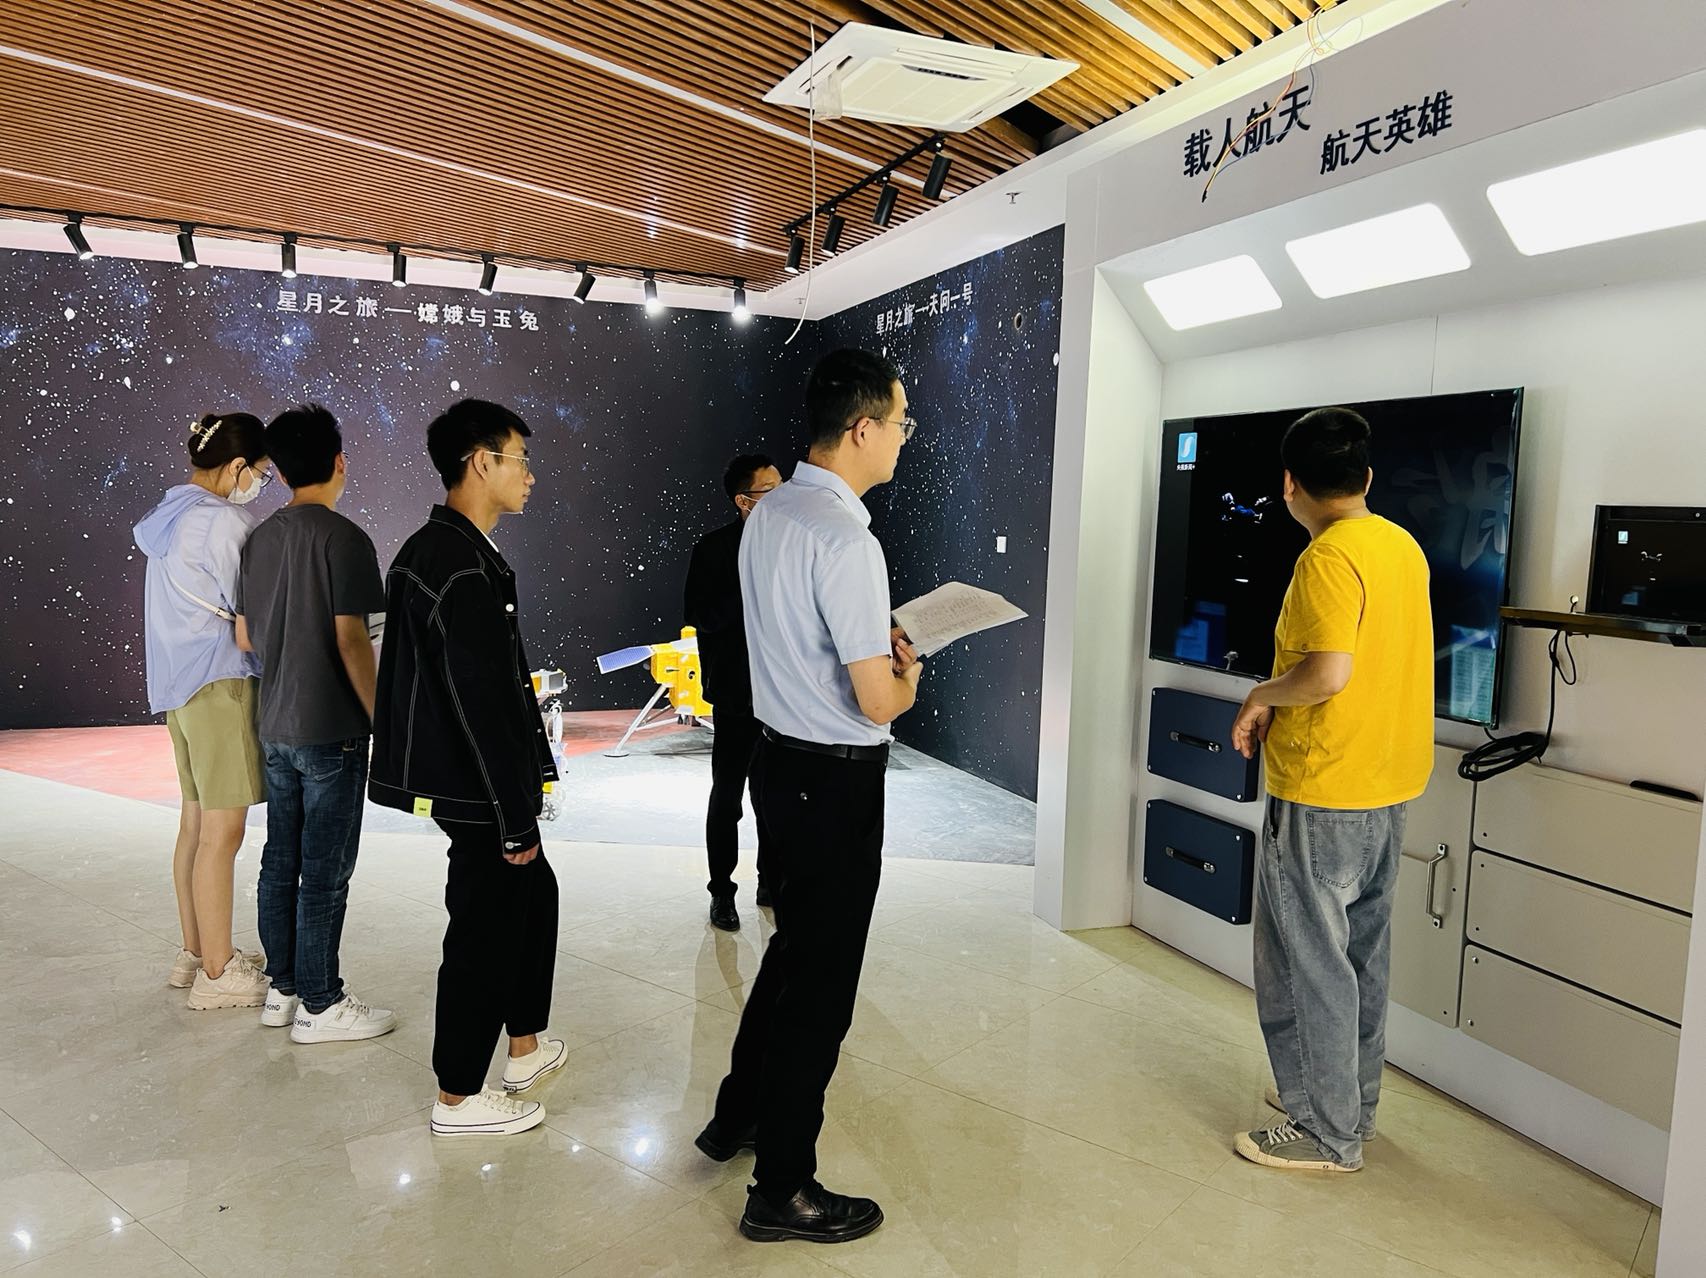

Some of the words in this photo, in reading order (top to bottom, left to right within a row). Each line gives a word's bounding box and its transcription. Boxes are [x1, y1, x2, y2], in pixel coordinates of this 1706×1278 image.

[1183, 85, 1311, 177] 载人航天
[1320, 90, 1453, 175] 航天英雄
